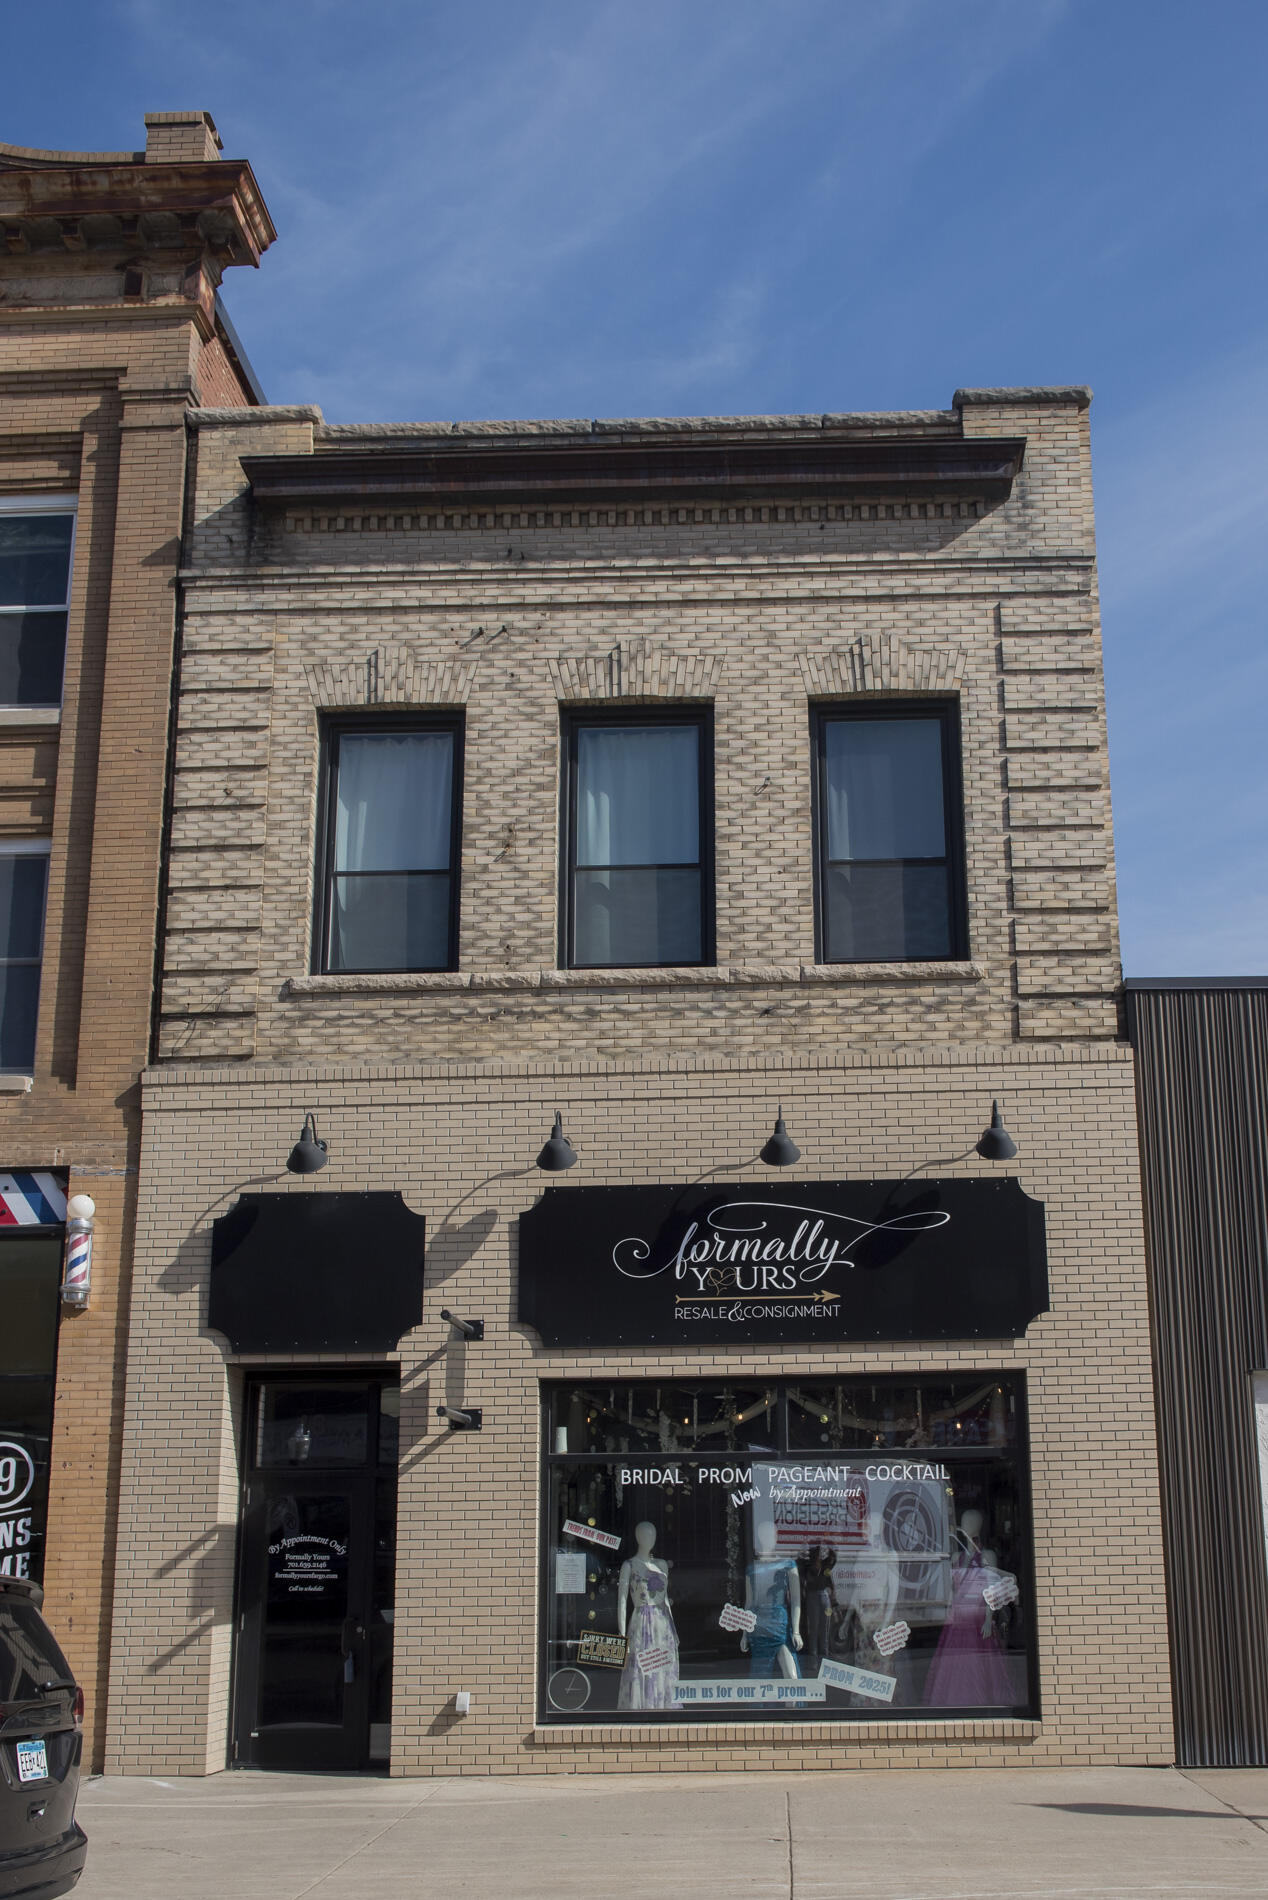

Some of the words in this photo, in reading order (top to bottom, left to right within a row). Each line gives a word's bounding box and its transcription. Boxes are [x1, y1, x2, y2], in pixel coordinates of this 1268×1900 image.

[674, 1219, 855, 1282] formally
[674, 1307, 728, 1320] RESALE
[744, 1304, 841, 1319] CONSIGNMENT
[621, 1468, 684, 1485] BRIDAL
[698, 1467, 752, 1484] PROM
[768, 1466, 850, 1482] PAGEANT
[865, 1464, 950, 1481] COCKTAIL
[769, 1486, 783, 1502] by
[784, 1485, 863, 1502] Appointment
[268, 1543, 280, 1554] By
[280, 1534, 329, 1549] Appointment
[329, 1540, 347, 1555] Only
[285, 1553, 312, 1561] Formally
[581, 1641, 626, 1659] CLOSED
[822, 1665, 854, 1686] PROM
[858, 1675, 891, 1696] 2025!
[674, 1685, 697, 1700] Join
[701, 1688, 714, 1699] us
[716, 1685, 732, 1698] for
[737, 1687, 754, 1698] our
[759, 1685, 774, 1698] 7th
[777, 1686, 807, 1699] prom
